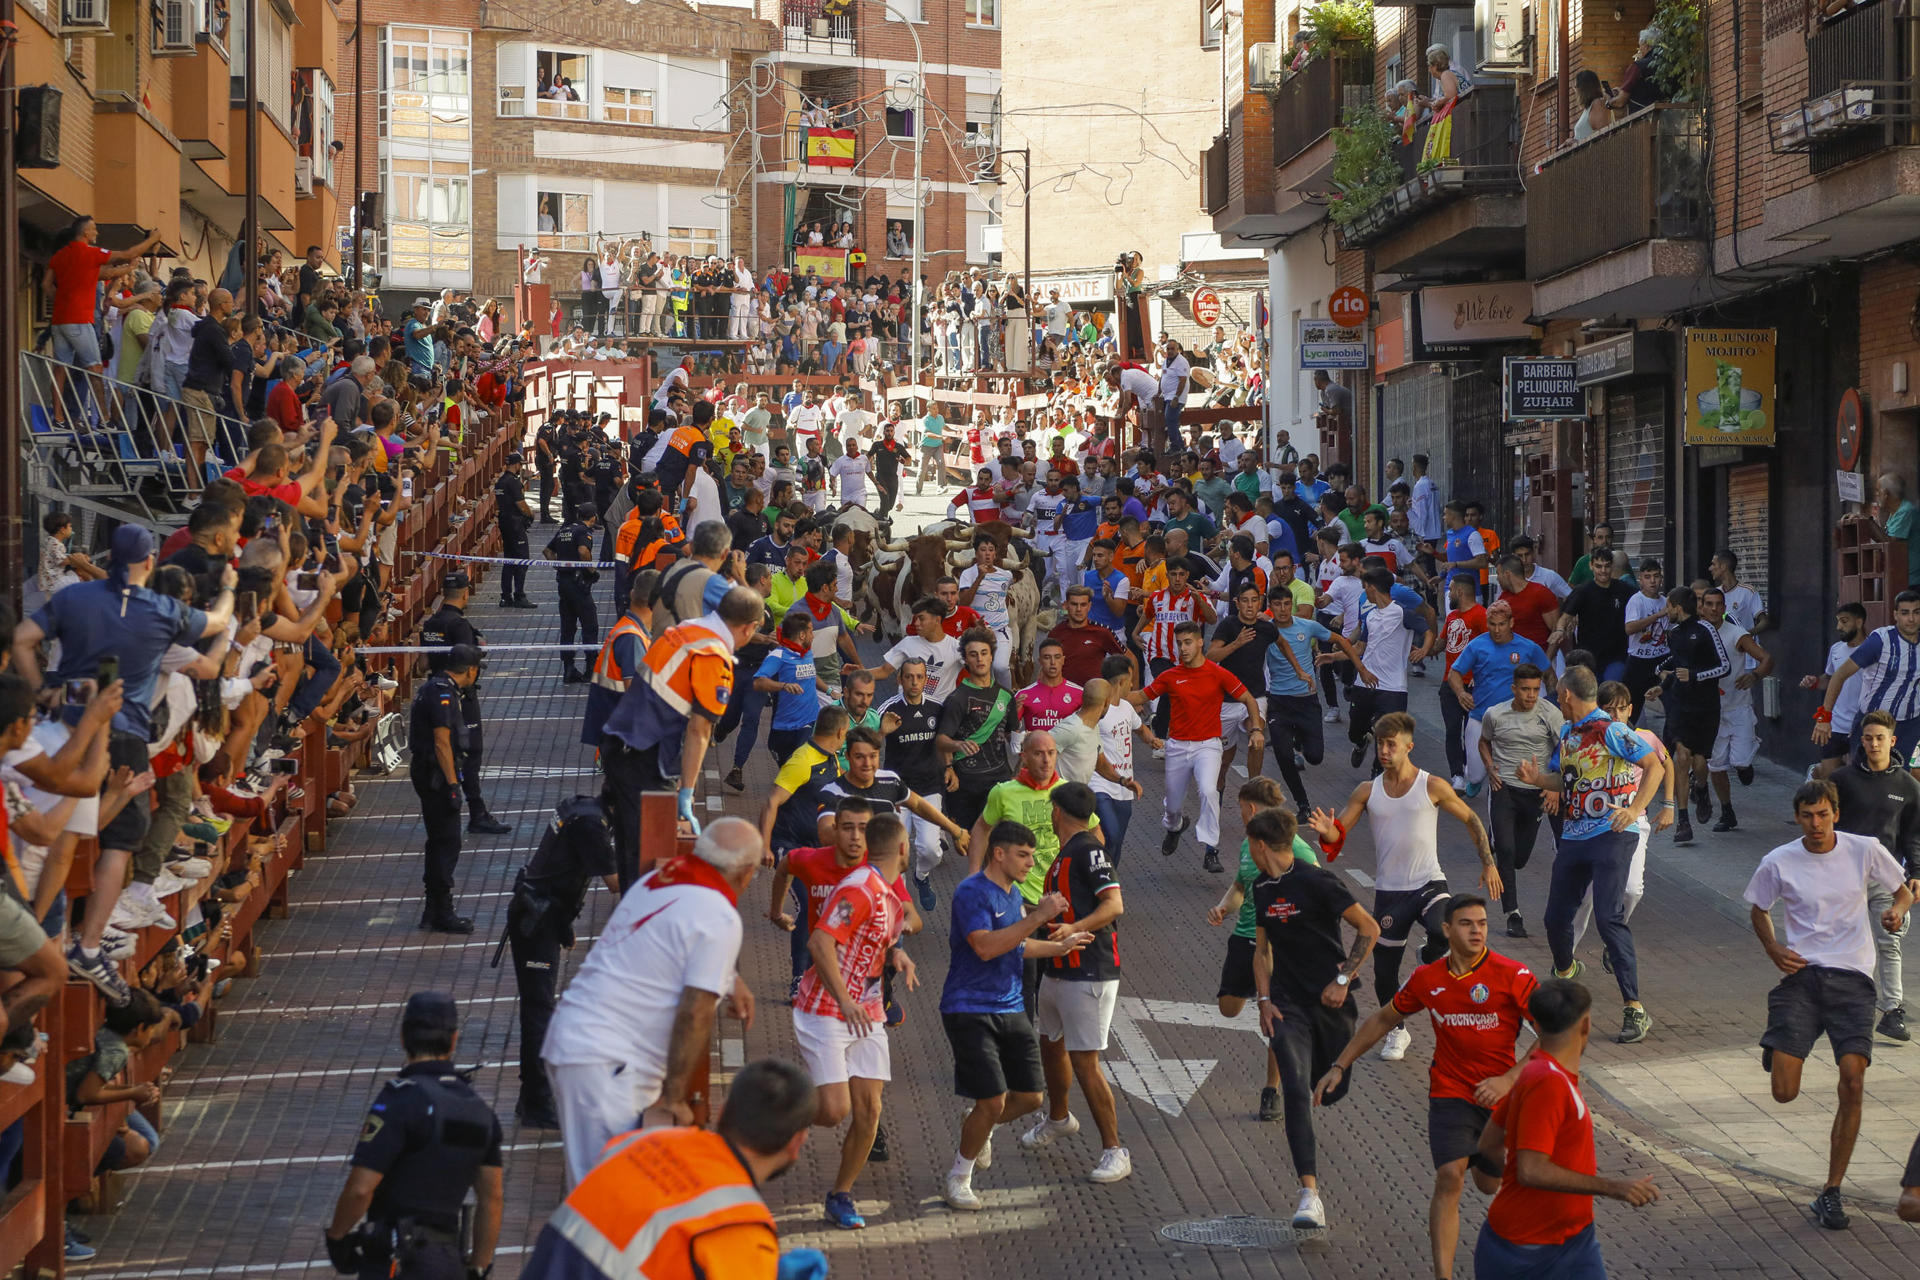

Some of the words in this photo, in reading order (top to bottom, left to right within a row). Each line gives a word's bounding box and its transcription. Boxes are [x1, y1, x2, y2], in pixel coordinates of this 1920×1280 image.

[1333, 291, 1365, 313] ria
[1693, 333, 1718, 342] PUB
[1721, 332, 1769, 342] JUNIOR
[1304, 348, 1363, 359] Lycamobile
[1706, 347, 1758, 357] MOJITO
[1523, 364, 1574, 378] BARBERIA
[1517, 380, 1580, 393] PELUQUERIA
[1522, 396, 1574, 407] ZUHAIR
[1044, 508, 1056, 520] tig
[1156, 612, 1189, 621] MARBELLA
[1045, 709, 1058, 717] Fly
[1032, 716, 1061, 726] Emira
[898, 732, 936, 743] SAMSUN
[811, 885, 834, 898] CAM
[1443, 1011, 1500, 1027] TECNOCASA
[1476, 1022, 1500, 1031] GROUP
